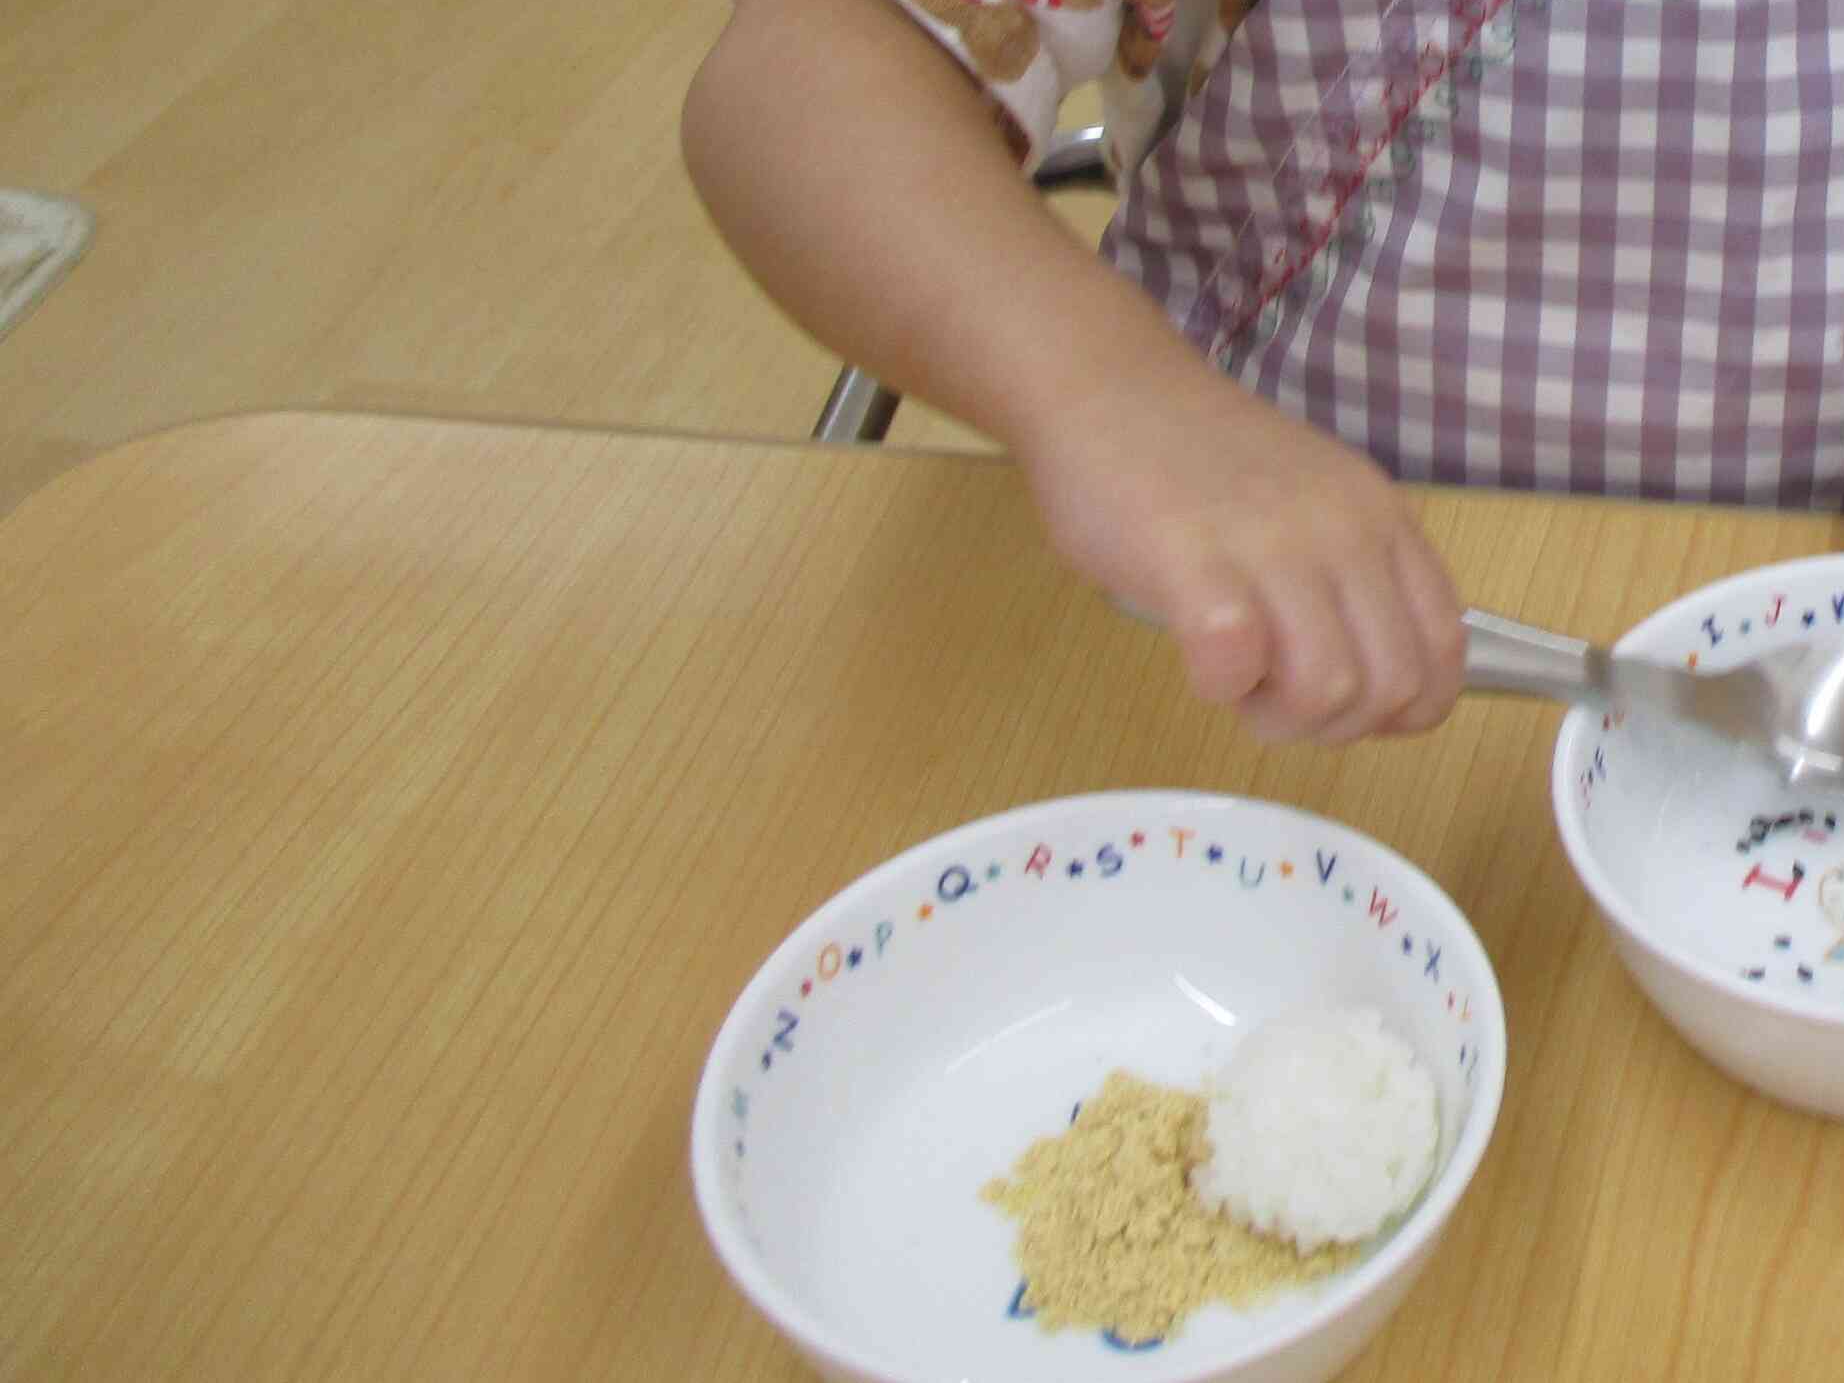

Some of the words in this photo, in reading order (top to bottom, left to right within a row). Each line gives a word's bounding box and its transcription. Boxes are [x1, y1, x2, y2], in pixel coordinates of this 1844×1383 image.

[1765, 593, 1785, 629] J
[816, 940, 842, 981] O
[936, 864, 978, 904] Q
[1024, 841, 1052, 880] R
[1096, 842, 1124, 878] S
[1168, 826, 1197, 859] T
[1238, 855, 1267, 889] U
[1315, 847, 1337, 886] V
[1368, 885, 1400, 929] W
[1423, 937, 1443, 984] X
